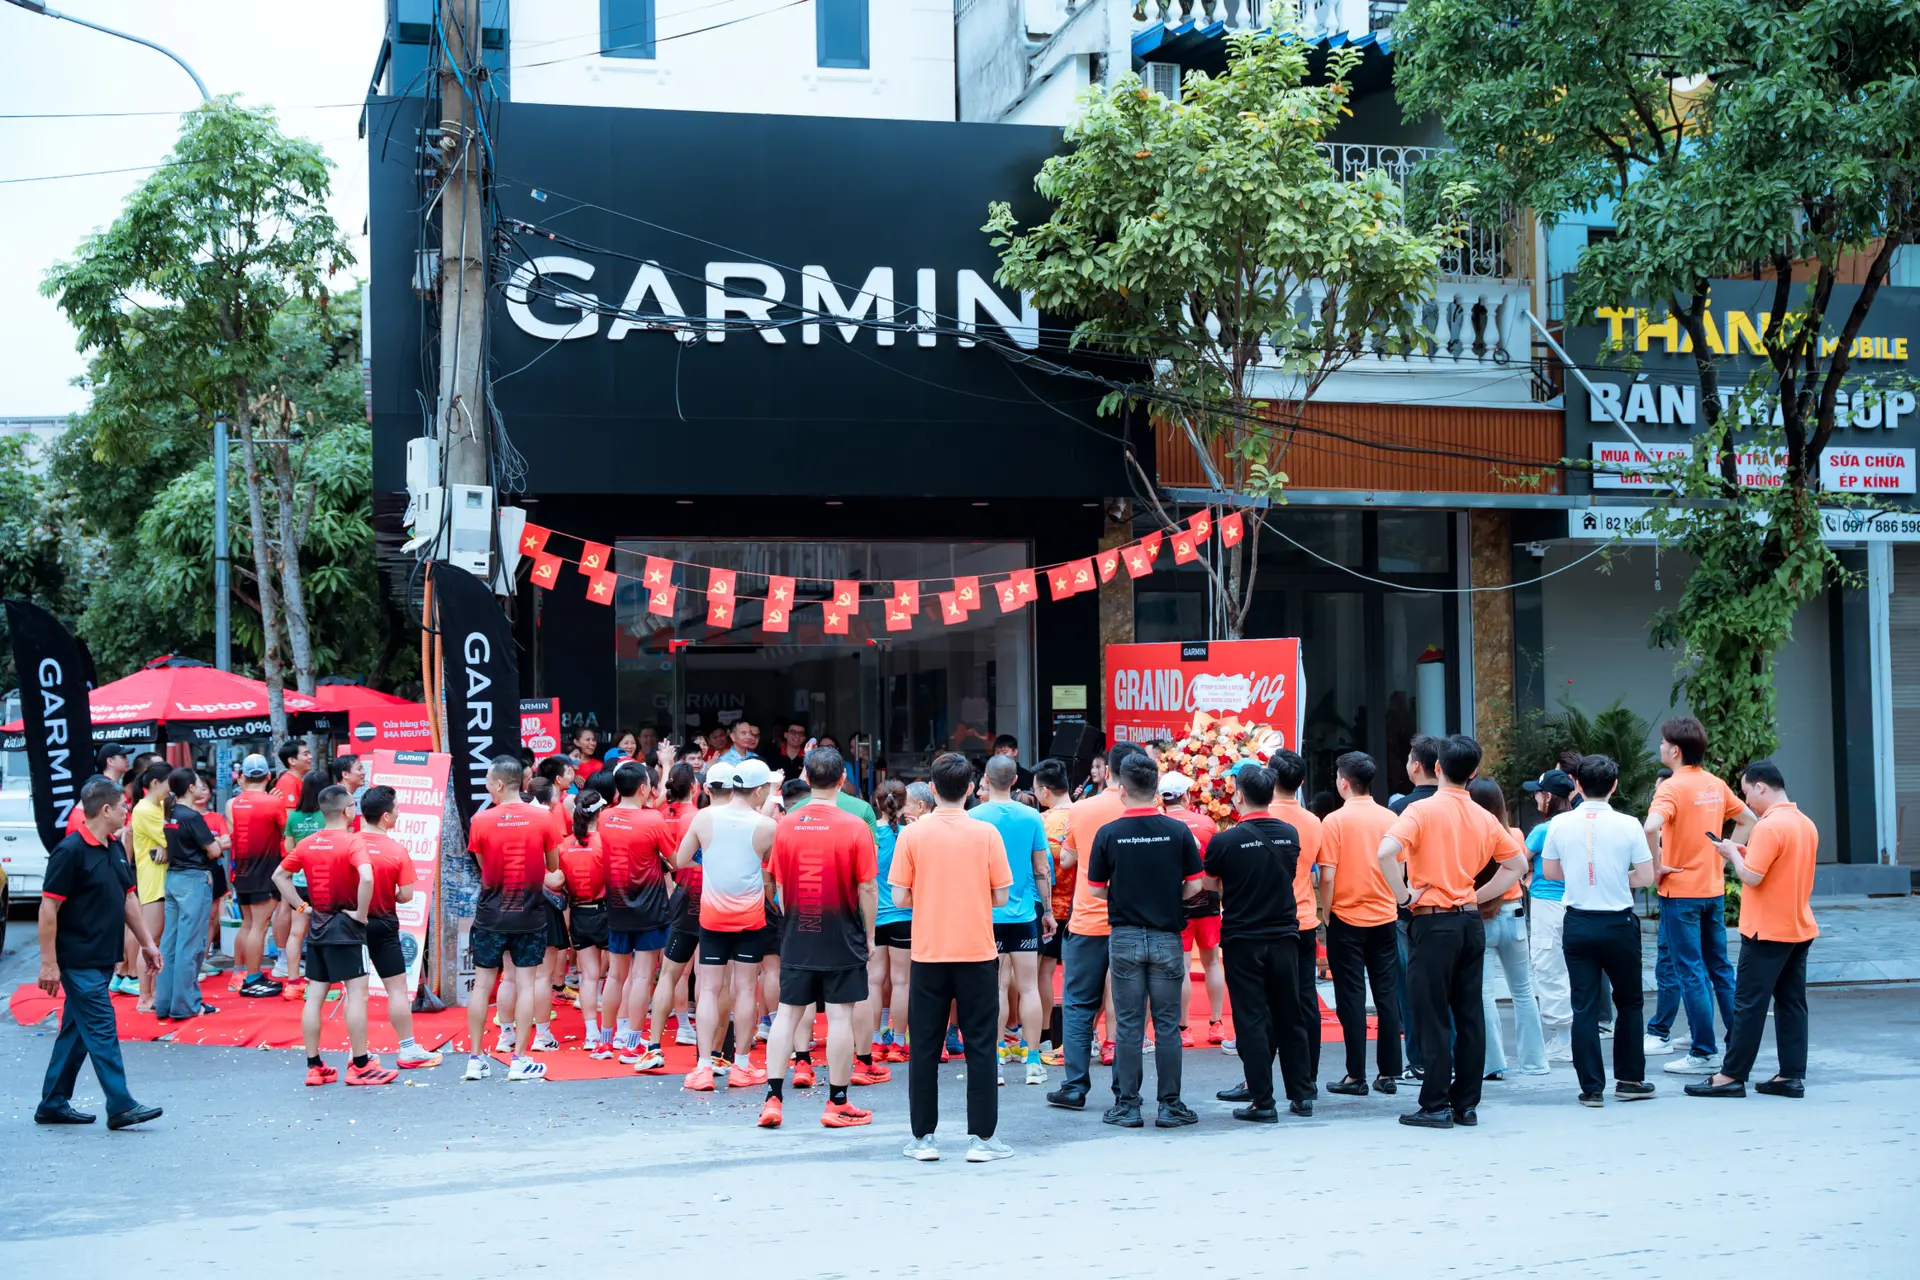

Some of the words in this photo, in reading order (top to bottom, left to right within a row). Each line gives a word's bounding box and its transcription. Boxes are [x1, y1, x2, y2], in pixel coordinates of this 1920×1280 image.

[504, 254, 1040, 350] GARMIN
[1590, 373, 1696, 424] BÁN
[1601, 450, 1630, 462] MUA
[1839, 473, 1858, 488] ÉP
[1863, 473, 1899, 488] KÍNH
[1605, 517, 1620, 530] 82
[1875, 520, 1898, 532] 886
[1183, 648, 1206, 657] GARMIN
[1114, 669, 1183, 711] GRAND
[175, 701, 257, 713] Laptop
[520, 702, 548, 710] ARMIN
[652, 693, 745, 708] GRMIN
[561, 711, 600, 728] 84A
[193, 726, 217, 739] TRẢ
[218, 726, 243, 737] GÓP
[245, 721, 272, 734] 0%
[38, 657, 75, 829] GARMIN
[532, 740, 552, 749] 2026
[397, 754, 425, 762] GARMIN
[405, 820, 427, 835] HOT
[798, 849, 823, 933] UNRUN
